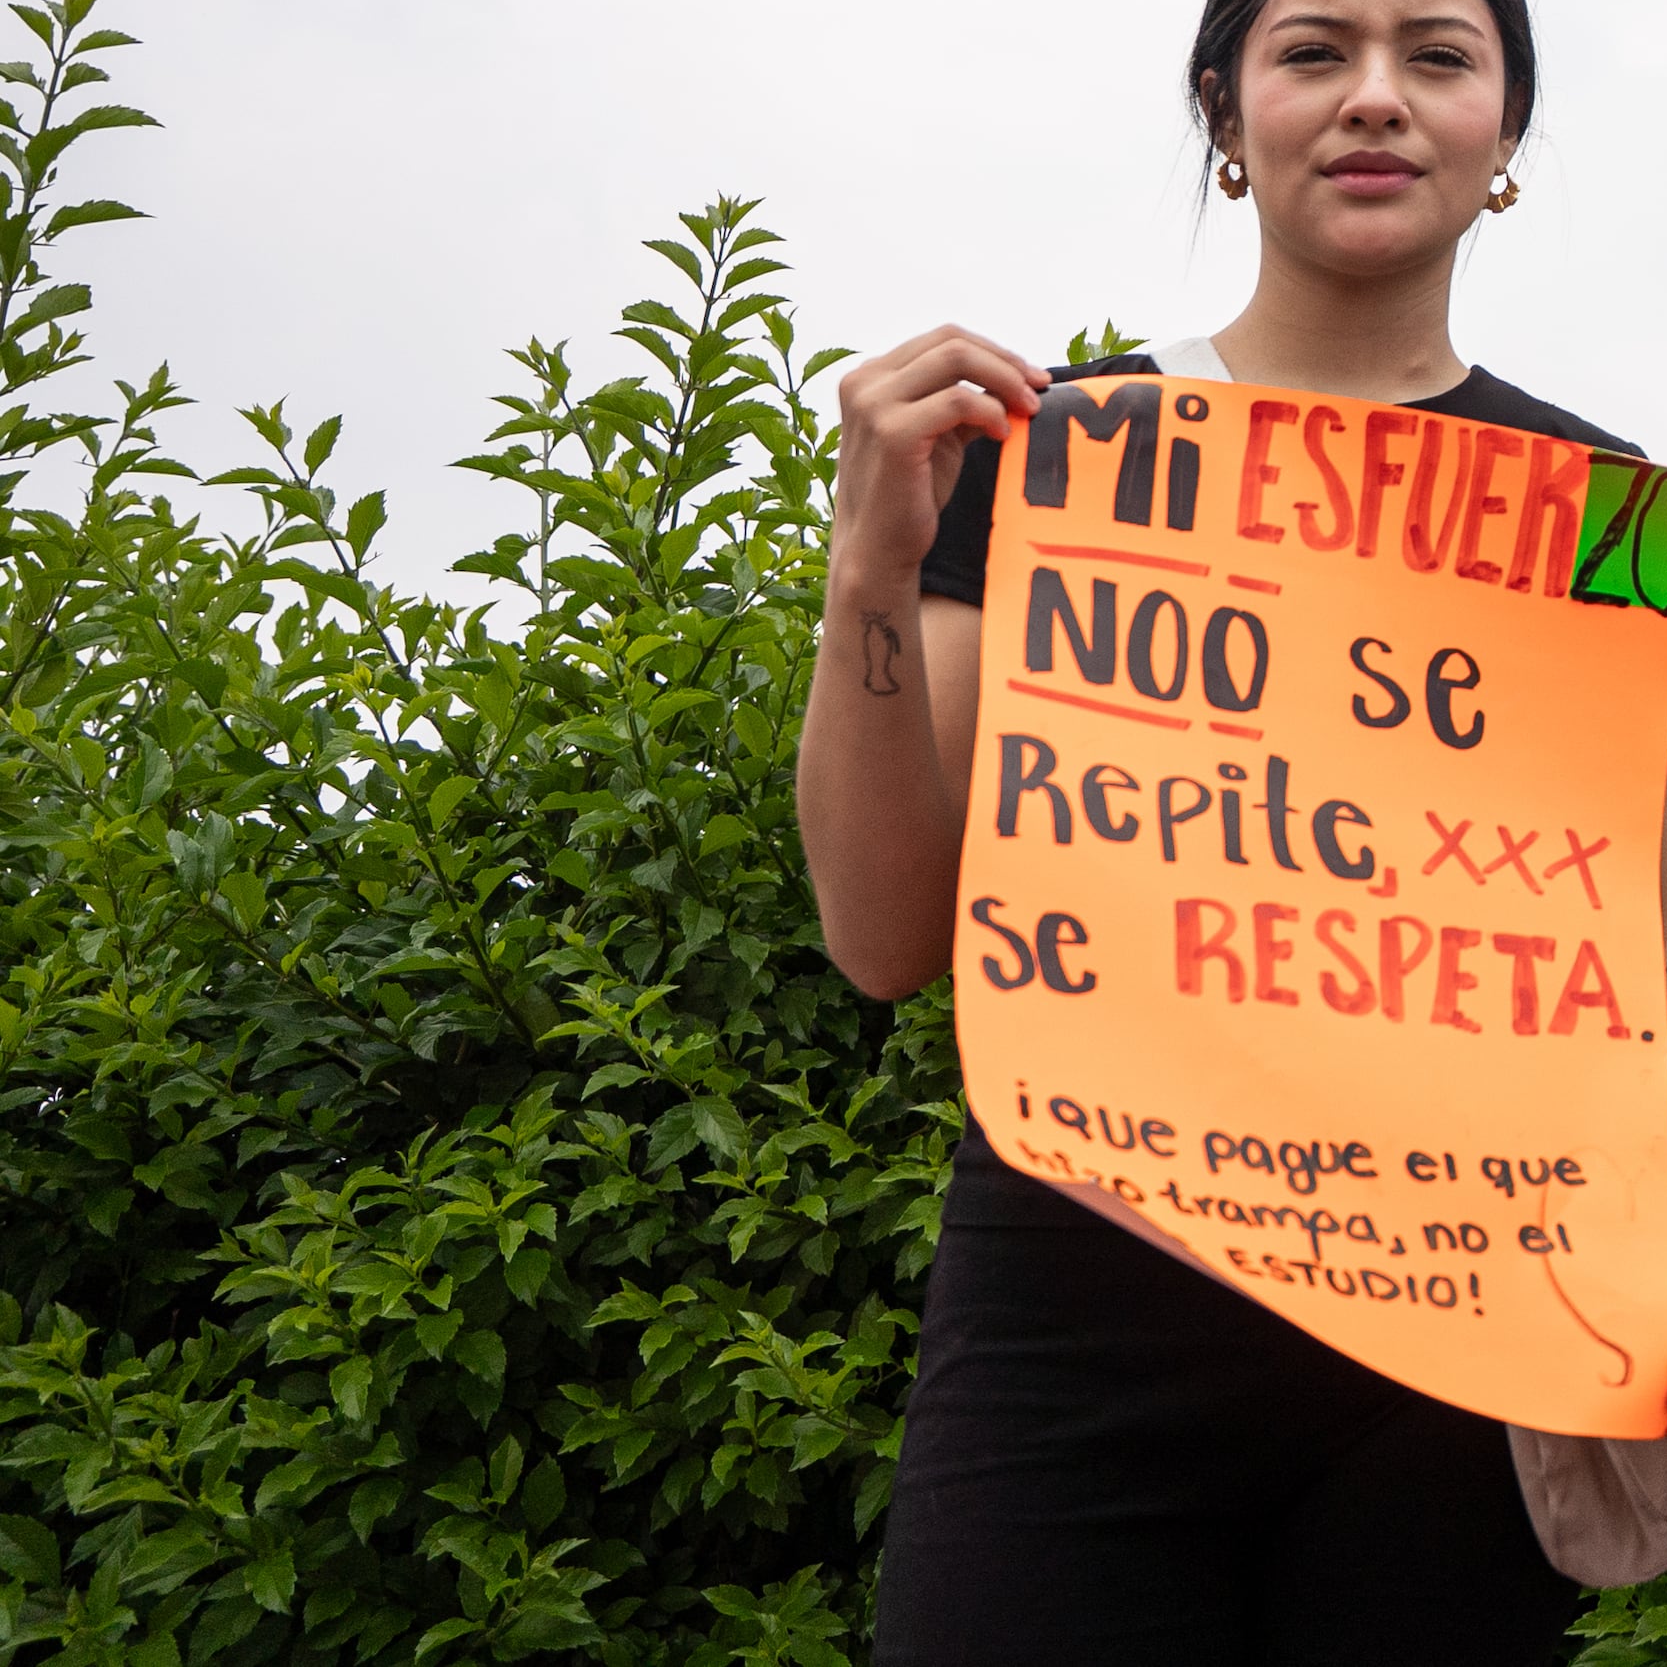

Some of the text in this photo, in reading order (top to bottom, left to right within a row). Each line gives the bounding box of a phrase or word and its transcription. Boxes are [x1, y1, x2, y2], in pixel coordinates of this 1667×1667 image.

[1023, 381, 1211, 531] Mi
[1025, 566, 1486, 750] NOO se
[1172, 897, 1657, 1046] RESPETA.
[1158, 1180, 1407, 1262] trampa,
[1422, 1222, 1490, 1254] no
[1519, 1219, 1574, 1257] el
[1203, 1129, 1379, 1195] pague
[1406, 1149, 1458, 1183] el
[1481, 1154, 1587, 1200] que
[1226, 1247, 1485, 1317] ESTUDIO!
